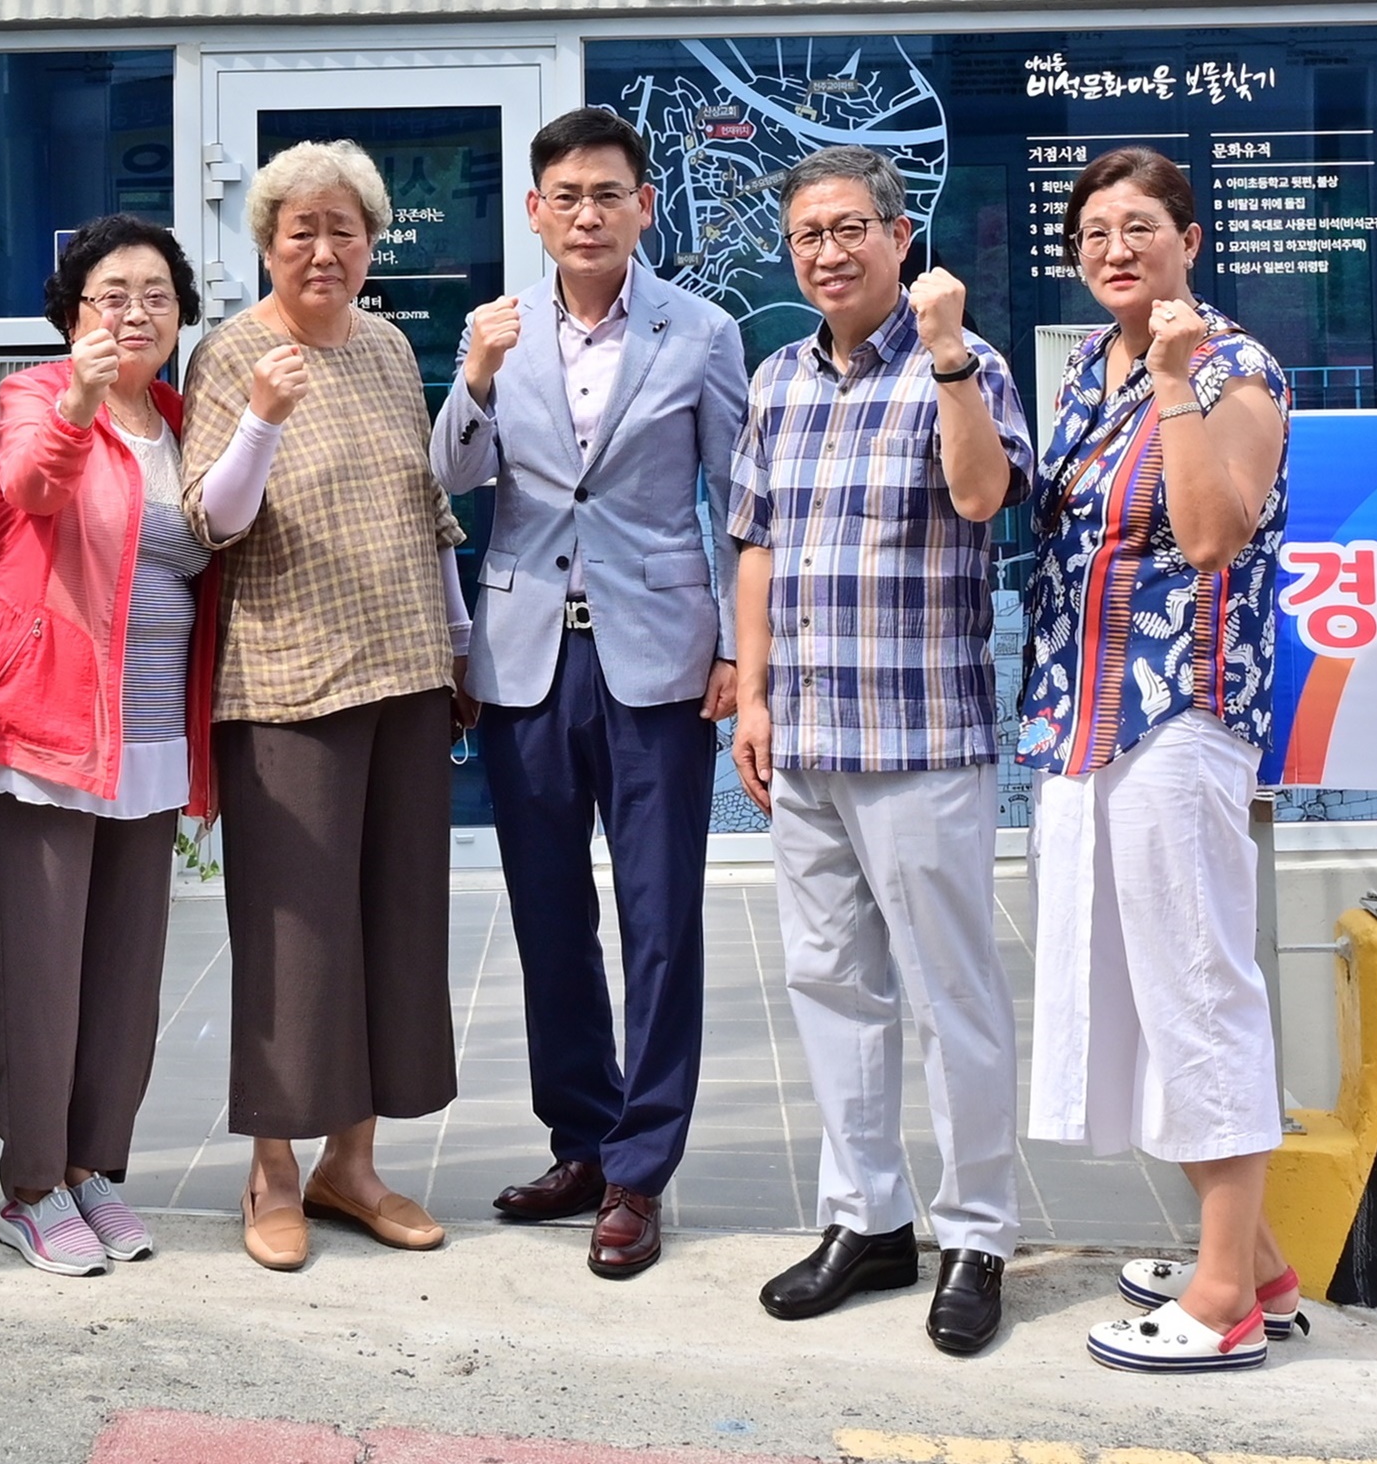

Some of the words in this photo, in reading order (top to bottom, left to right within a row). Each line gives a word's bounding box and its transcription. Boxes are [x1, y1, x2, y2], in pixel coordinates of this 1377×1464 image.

[1024, 53, 1067, 72] 아미동
[1026, 65, 1177, 100] 비석문화마을
[1185, 61, 1276, 105] 보물찾기
[1028, 145, 1088, 163] 거점시설
[1211, 142, 1271, 158] 문화유적
[1029, 182, 1035, 192] 1
[1213, 179, 1222, 189] A
[1226, 177, 1289, 189] 아미초등학교
[1029, 203, 1037, 214] 2
[1042, 202, 1070, 215] 기찻
[1213, 199, 1223, 210] B
[1260, 198, 1283, 210] 위에
[395, 207, 446, 224] 공존하는
[1030, 224, 1038, 235] 3
[1214, 221, 1224, 231] C
[1228, 219, 1249, 232] 집에
[1285, 218, 1317, 231] 사용된
[1030, 245, 1038, 256] 4
[1215, 242, 1224, 253] D
[1272, 240, 1284, 252] 집
[1031, 266, 1039, 277] 5
[1217, 263, 1225, 274] E
[1229, 262, 1261, 275] 대성사
[1262, 261, 1295, 274] 일본인
